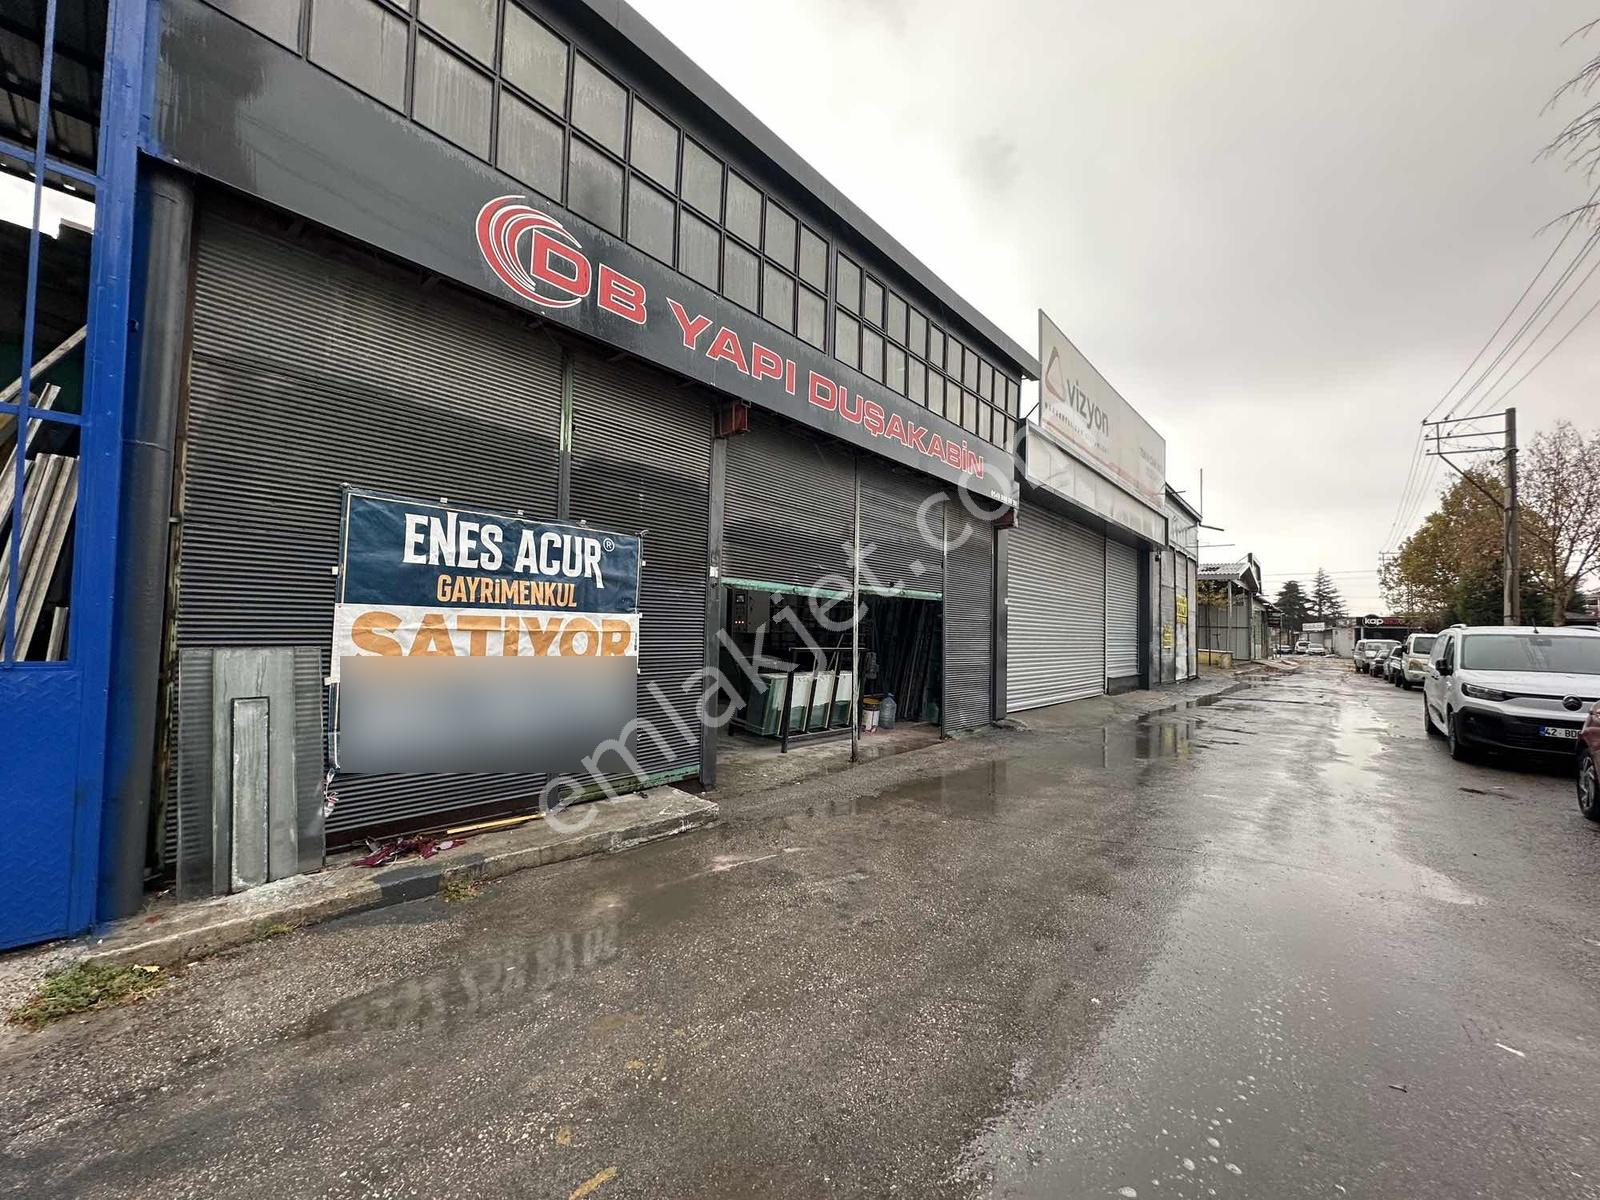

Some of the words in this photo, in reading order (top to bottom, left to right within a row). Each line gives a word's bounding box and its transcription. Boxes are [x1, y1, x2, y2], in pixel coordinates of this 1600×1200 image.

[665, 297, 797, 396] YAPI
[808, 370, 984, 480] DUŞAKABİN
[1066, 378, 1109, 437] vizyon
[402, 511, 504, 572] ENES
[351, 611, 632, 657] SATIYOR
